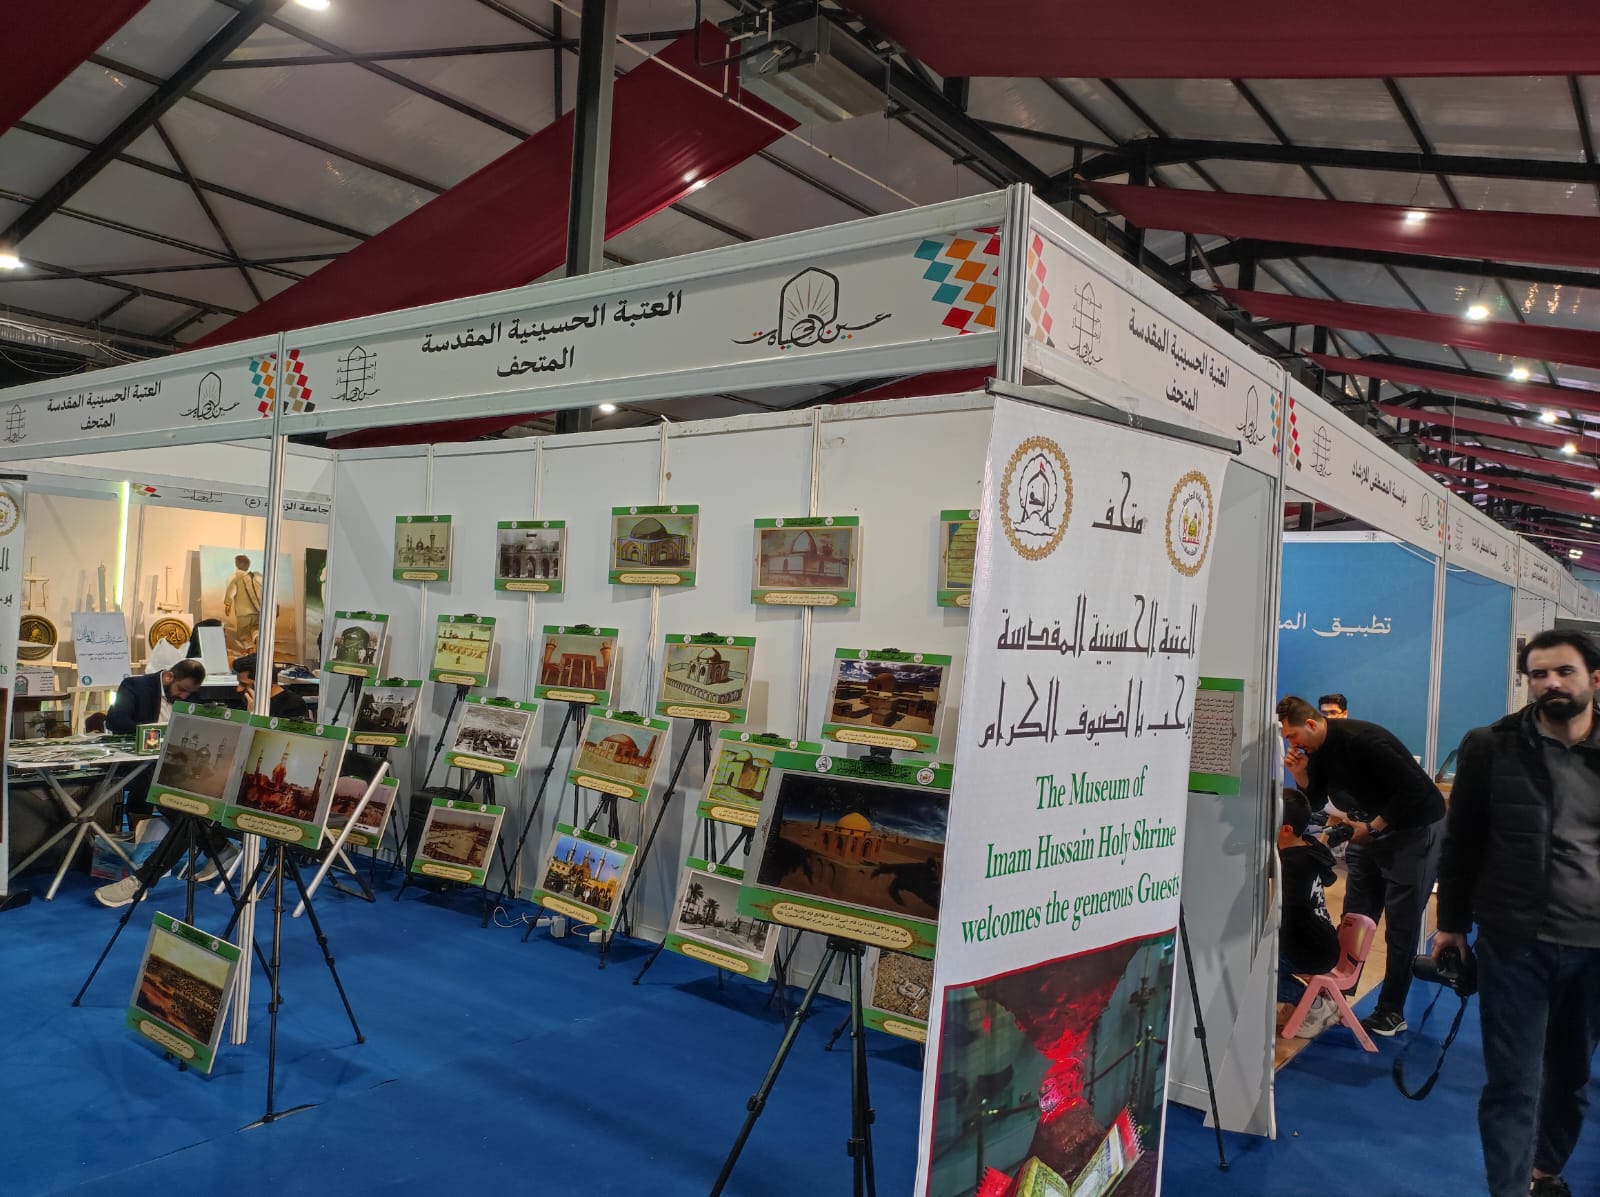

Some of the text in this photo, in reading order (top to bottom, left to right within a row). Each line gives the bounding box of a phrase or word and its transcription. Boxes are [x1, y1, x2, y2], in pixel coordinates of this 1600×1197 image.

[421, 289, 682, 353] العتبة الحسينية المقدسة
[1129, 308, 1169, 353] المقدسة
[496, 345, 574, 377] المتحف
[1171, 333, 1207, 376] الحسينية
[1209, 358, 1229, 388] العتبة
[47, 380, 162, 412] العتبة الحسينية المقدسة
[1166, 378, 1198, 412] المتحف
[80, 413, 116, 431] المتحف
[997, 592, 1197, 665] العتبة الحسينية المقدسة
[1312, 613, 1391, 638] تطبيق
[978, 673, 1060, 748] الكرام
[1036, 764, 1148, 809] The Museum of
[985, 817, 1176, 879] Imam Hussain Holy Shrine
[961, 872, 1180, 945] welcomes the generous Guests
